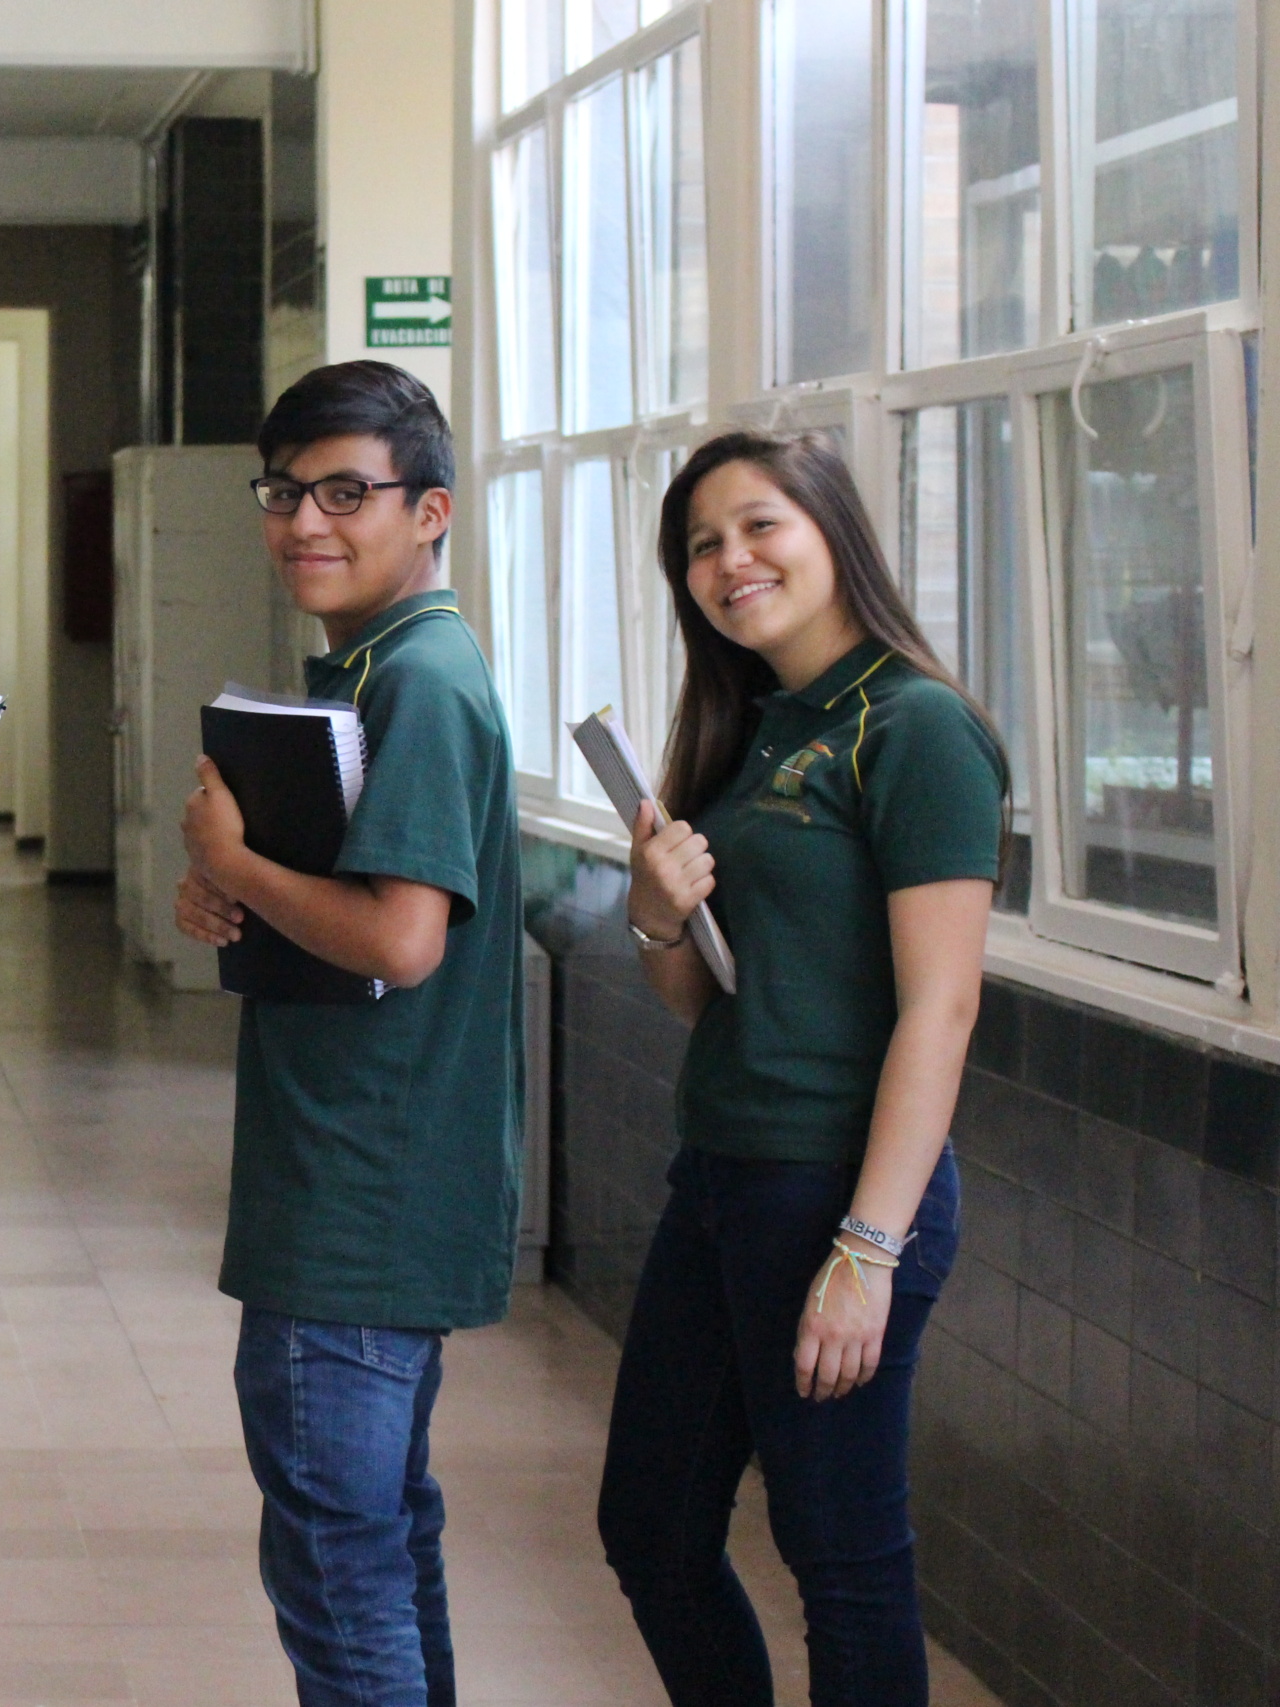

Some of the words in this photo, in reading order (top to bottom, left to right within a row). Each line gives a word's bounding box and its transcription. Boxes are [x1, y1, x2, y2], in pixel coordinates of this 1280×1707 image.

[382, 278, 418, 295] RUTA
[428, 278, 445, 294] DE
[845, 1218, 886, 1244] NBHD
